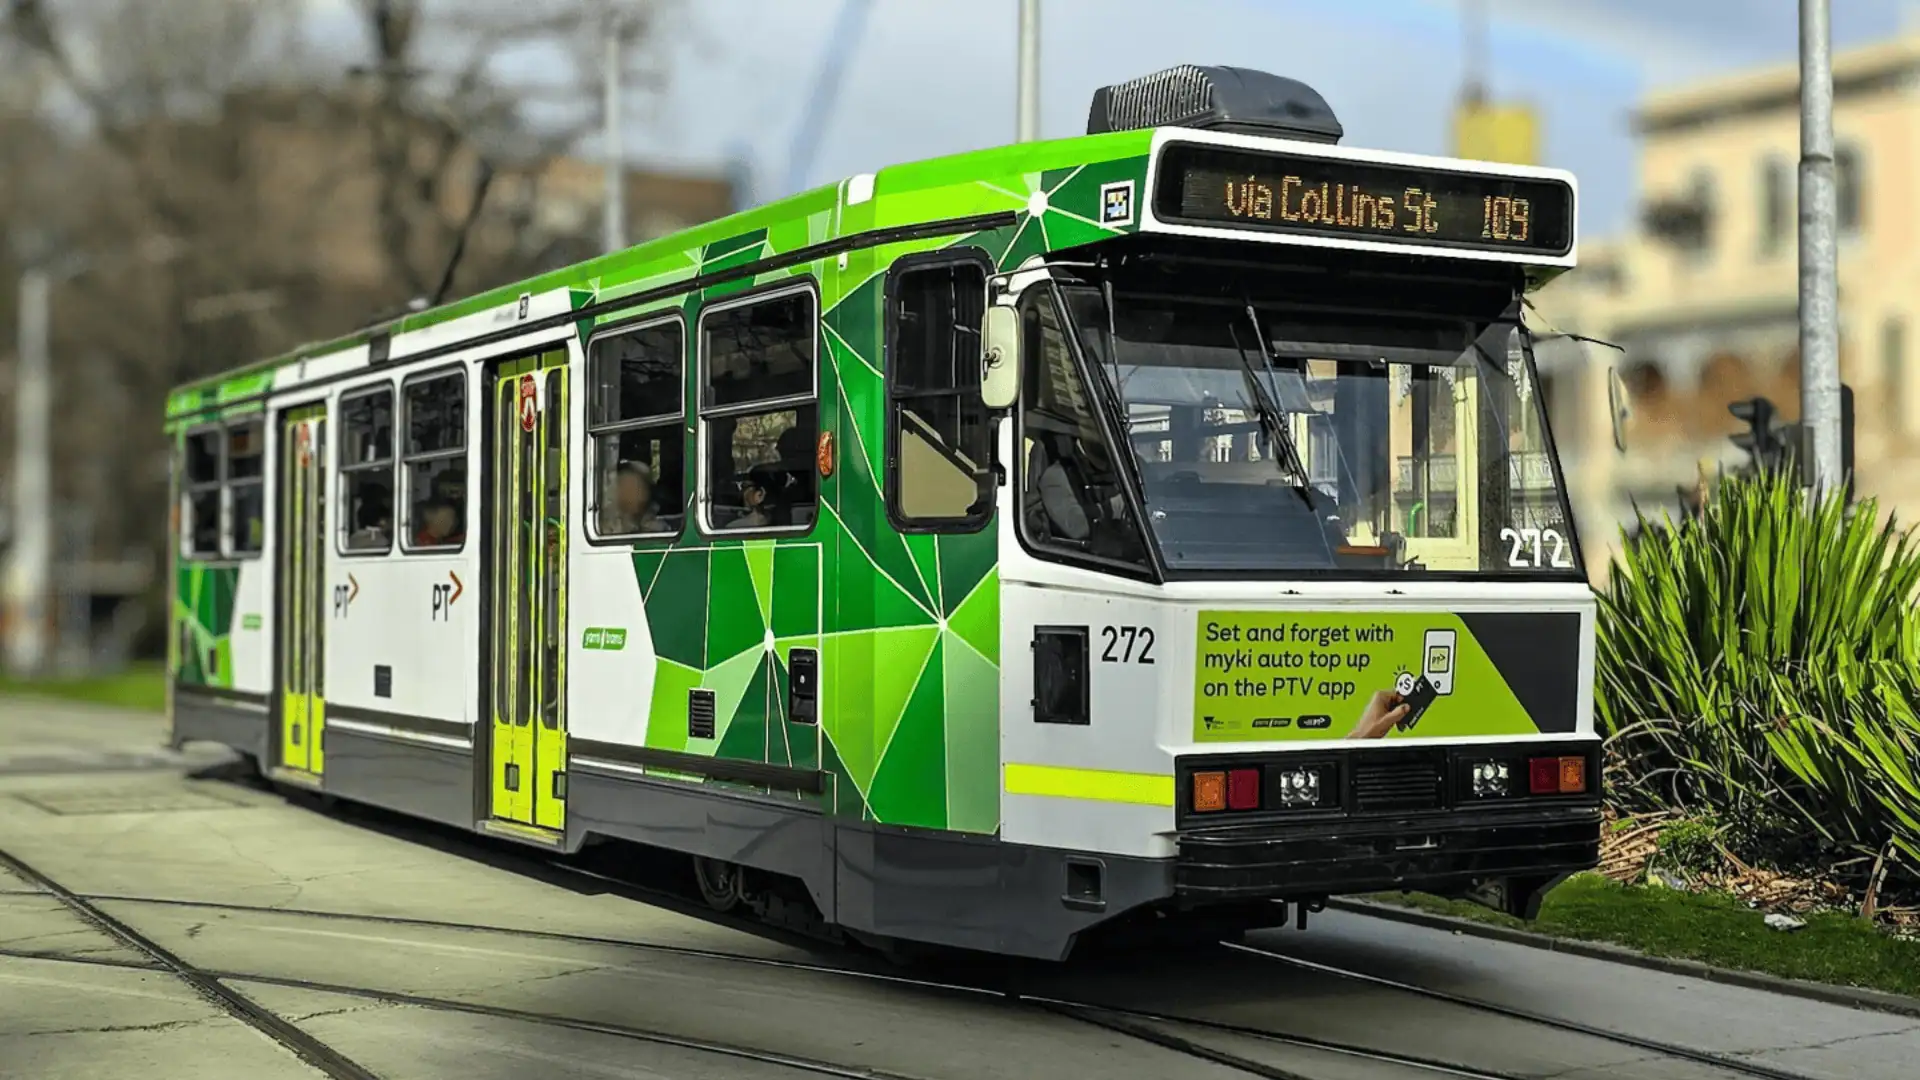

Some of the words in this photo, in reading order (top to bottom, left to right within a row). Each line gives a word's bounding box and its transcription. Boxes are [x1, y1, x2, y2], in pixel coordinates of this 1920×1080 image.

[1224, 175, 1272, 219] via
[1279, 175, 1395, 230] Collins
[1403, 187, 1438, 233] St
[1481, 195, 1530, 241] 109
[1500, 527, 1575, 568] 272
[1101, 625, 1155, 664] 272
[1206, 622, 1241, 642] Set
[1246, 623, 1285, 642] and
[1290, 623, 1350, 647] forget
[1355, 624, 1394, 642] with
[1204, 649, 1252, 673] myki
[1258, 650, 1304, 668] auto
[1309, 650, 1341, 672] top
[1346, 653, 1370, 672] up
[1203, 682, 1229, 697] on
[1234, 677, 1267, 697] the
[1272, 677, 1314, 696] PTV
[1318, 682, 1355, 700] app
